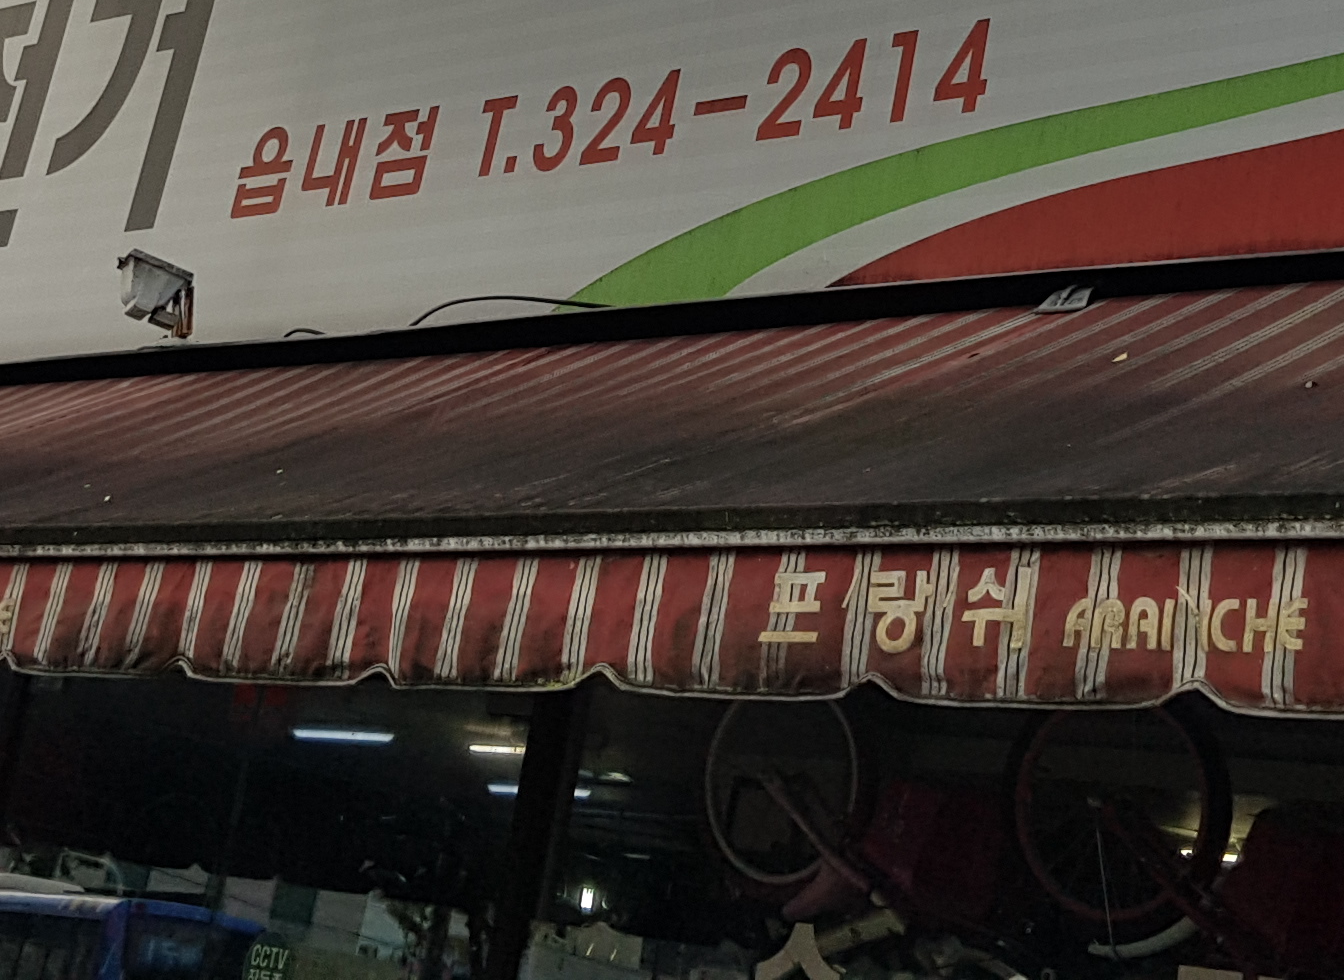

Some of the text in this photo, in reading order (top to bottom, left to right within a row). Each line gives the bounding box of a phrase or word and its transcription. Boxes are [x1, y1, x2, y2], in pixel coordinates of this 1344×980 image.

[230, 18, 992, 220] 읍내점 T.324-2414
[250, 943, 290, 970] CCTV
